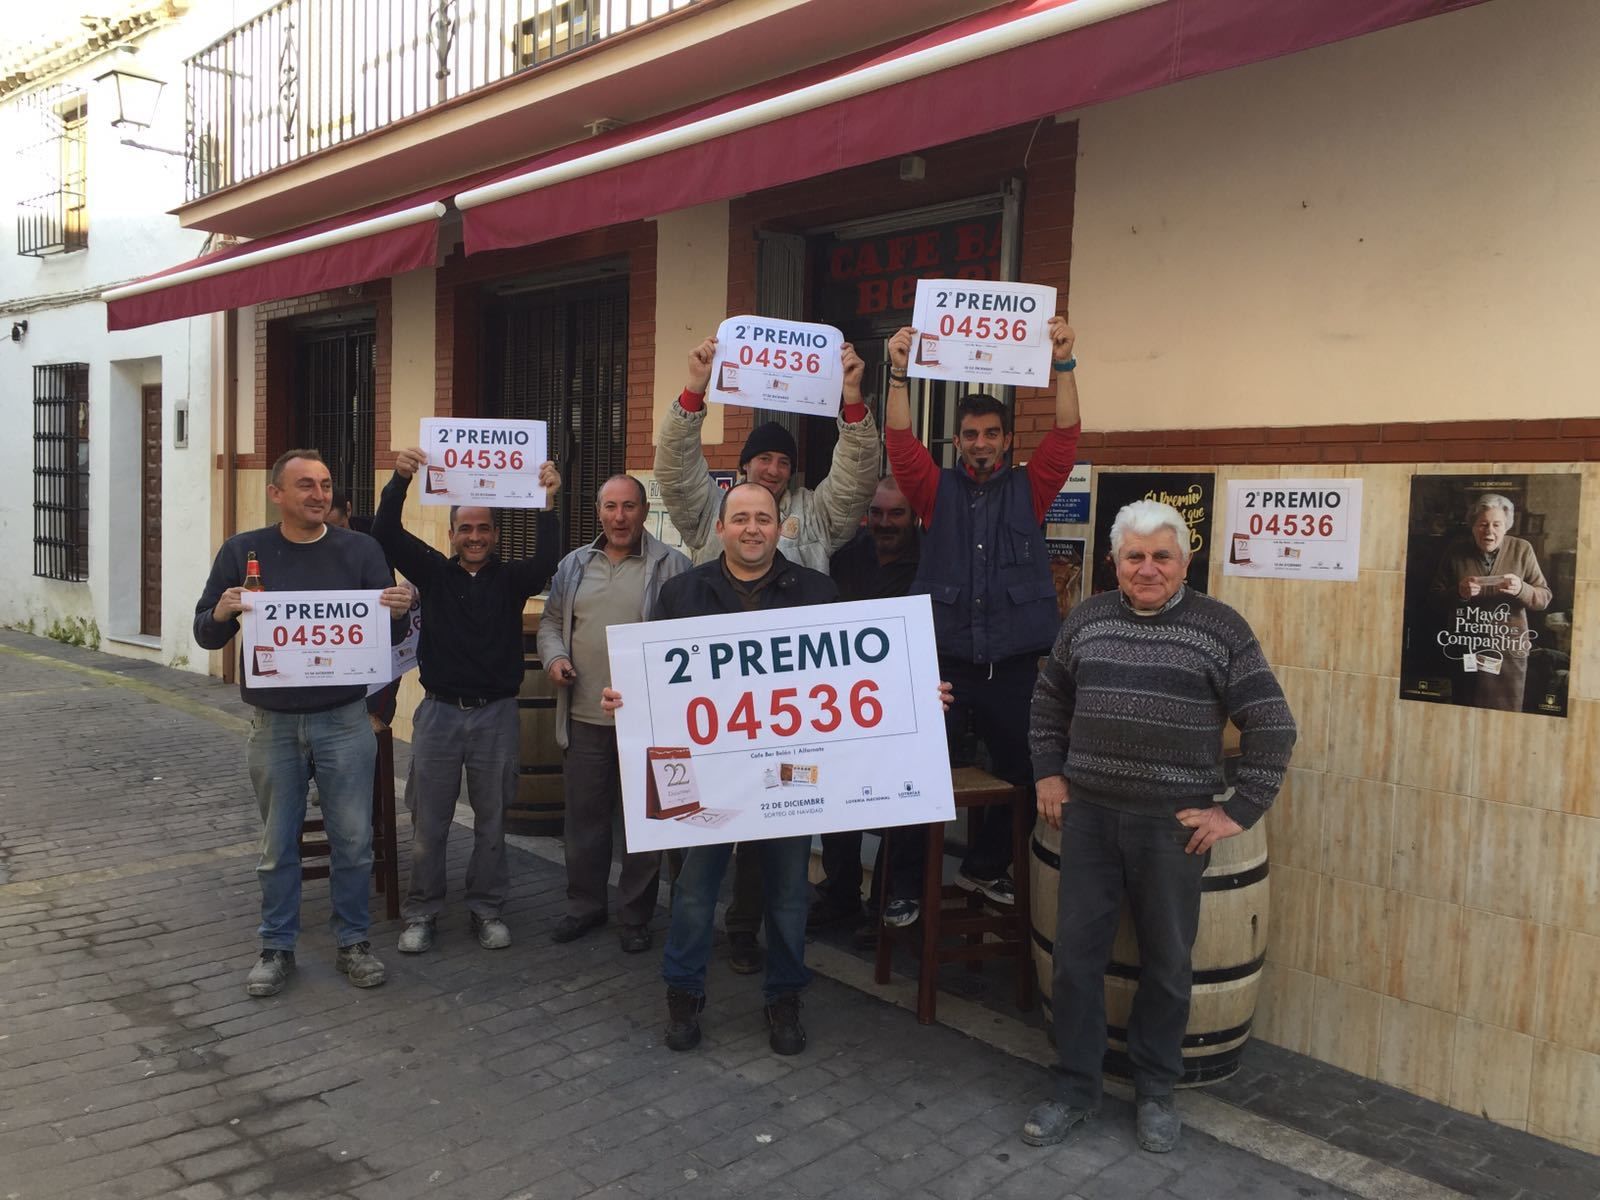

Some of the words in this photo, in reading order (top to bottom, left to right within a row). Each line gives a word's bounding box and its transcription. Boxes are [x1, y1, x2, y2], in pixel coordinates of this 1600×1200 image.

[831, 231, 941, 281] CAFE
[955, 292, 1036, 313] PREMIO
[753, 327, 828, 348] PREMIO
[939, 314, 1027, 342] 04536
[740, 345, 821, 374] 04536
[456, 429, 529, 446] PREMIO
[444, 448, 524, 470] 04536
[1160, 484, 1202, 506] Premio
[1262, 491, 1341, 508] PREMIO
[1249, 514, 1334, 537] 04536
[285, 602, 369, 620] PREMIO
[1466, 603, 1511, 624] Mayor
[272, 624, 364, 647] 04536
[1455, 617, 1509, 636] Premio
[709, 626, 890, 680] PREMIO
[686, 679, 884, 746] 04536
[664, 763, 690, 787] 22
[784, 797, 825, 808] DICIEMBRE
